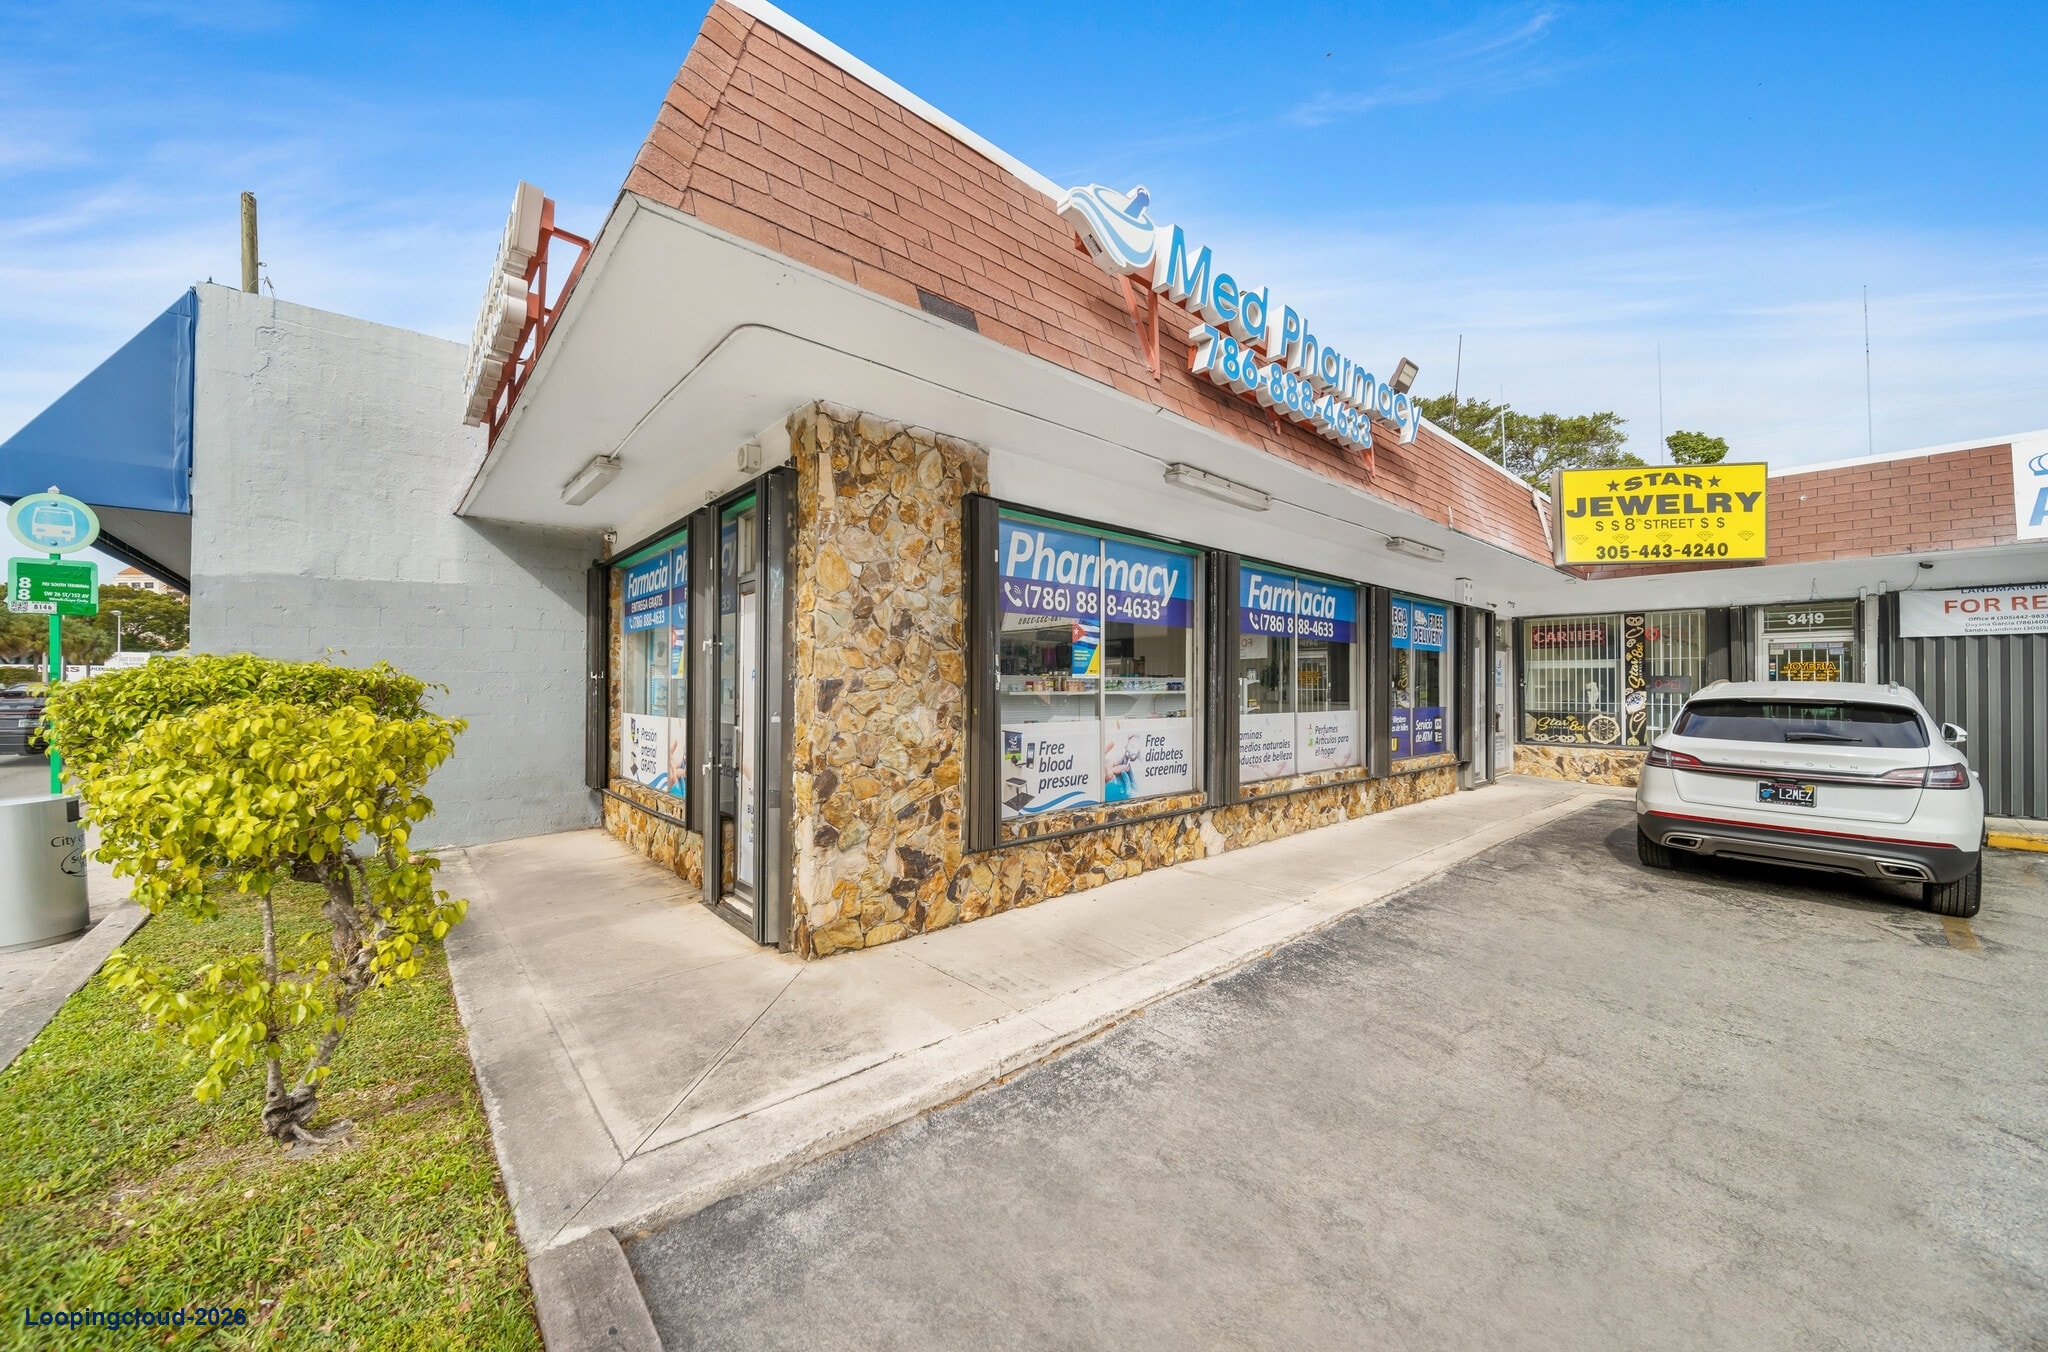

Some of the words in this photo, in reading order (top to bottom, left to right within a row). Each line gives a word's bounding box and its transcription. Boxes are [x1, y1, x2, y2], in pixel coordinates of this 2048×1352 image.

[1166, 224, 1269, 342] Med
[1280, 304, 1422, 445] Pharmacy
[1203, 323, 1373, 449] 786-888-4633
[1623, 472, 1703, 492] STAR
[1566, 491, 1763, 518] JEWELRY
[1643, 518, 1695, 530] STREET
[1596, 542, 1729, 560] 305-443-4240
[1005, 531, 1179, 607] Pharmacy
[18, 577, 31, 589] 8
[627, 560, 668, 599] Farmacia
[17, 588, 31, 600] 8
[1024, 583, 1071, 612] (786)
[1075, 591, 1161, 620] 888-4633
[1247, 574, 1336, 619] Farmacia
[1944, 597, 2001, 615] FOR
[1260, 613, 1285, 633] (786)
[1287, 618, 1334, 638] 888-4633
[1428, 613, 1443, 630] FREE
[1787, 612, 1825, 625] 3419
[1413, 627, 1443, 646] DELIVERY
[1314, 724, 1339, 736] Perfumes
[1415, 719, 1432, 730] Servicio
[1145, 734, 1165, 747] Free
[1262, 739, 1291, 751] naturales
[1337, 735, 1349, 745] para
[1415, 731, 1422, 743] de
[1422, 731, 1433, 742] ATM
[1038, 741, 1065, 756] Free
[1144, 748, 1184, 762] diabetes
[1314, 748, 1320, 757] el
[1320, 746, 1336, 758] hogar
[1038, 755, 1074, 773] blood
[1239, 754, 1262, 766] ductos
[1262, 752, 1272, 763] de
[1271, 751, 1293, 763] belleza
[1722, 756, 1858, 770] LINCOLN
[1144, 761, 1188, 778] screening
[1038, 773, 1089, 794] pressure
[50, 835, 76, 848] City
